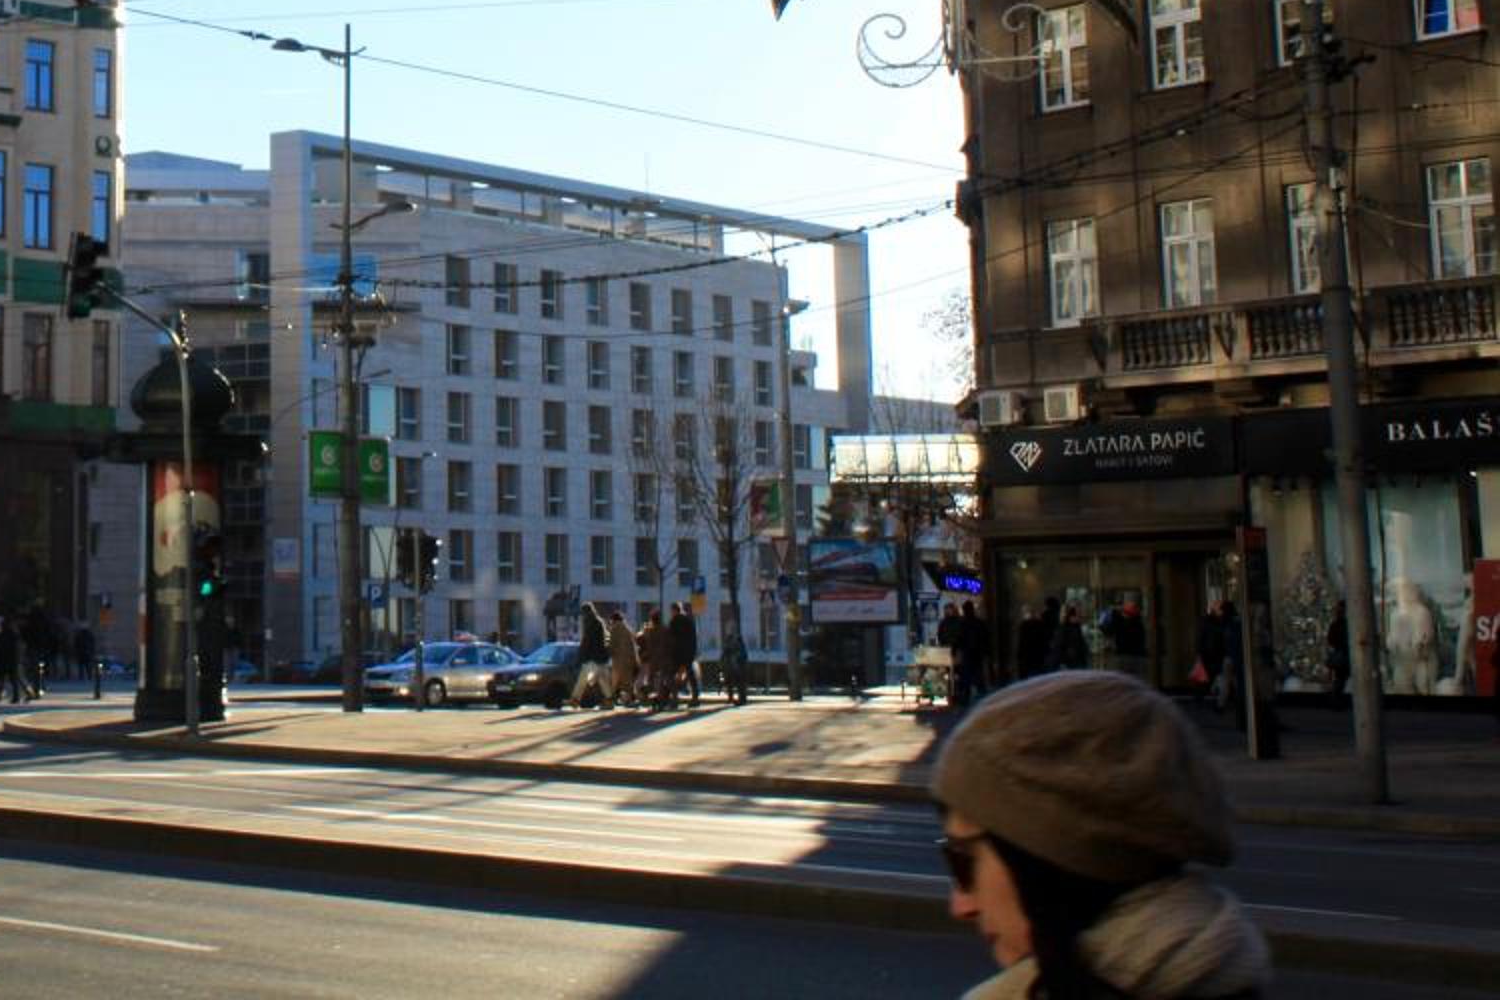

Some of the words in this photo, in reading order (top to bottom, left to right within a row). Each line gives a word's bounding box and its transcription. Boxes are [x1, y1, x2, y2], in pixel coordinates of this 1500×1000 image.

[1387, 411, 1500, 441] BALAŠ
[1063, 434, 1145, 456] ZLATARA
[1151, 427, 1205, 451] PAPIĆ
[371, 585, 382, 601] P
